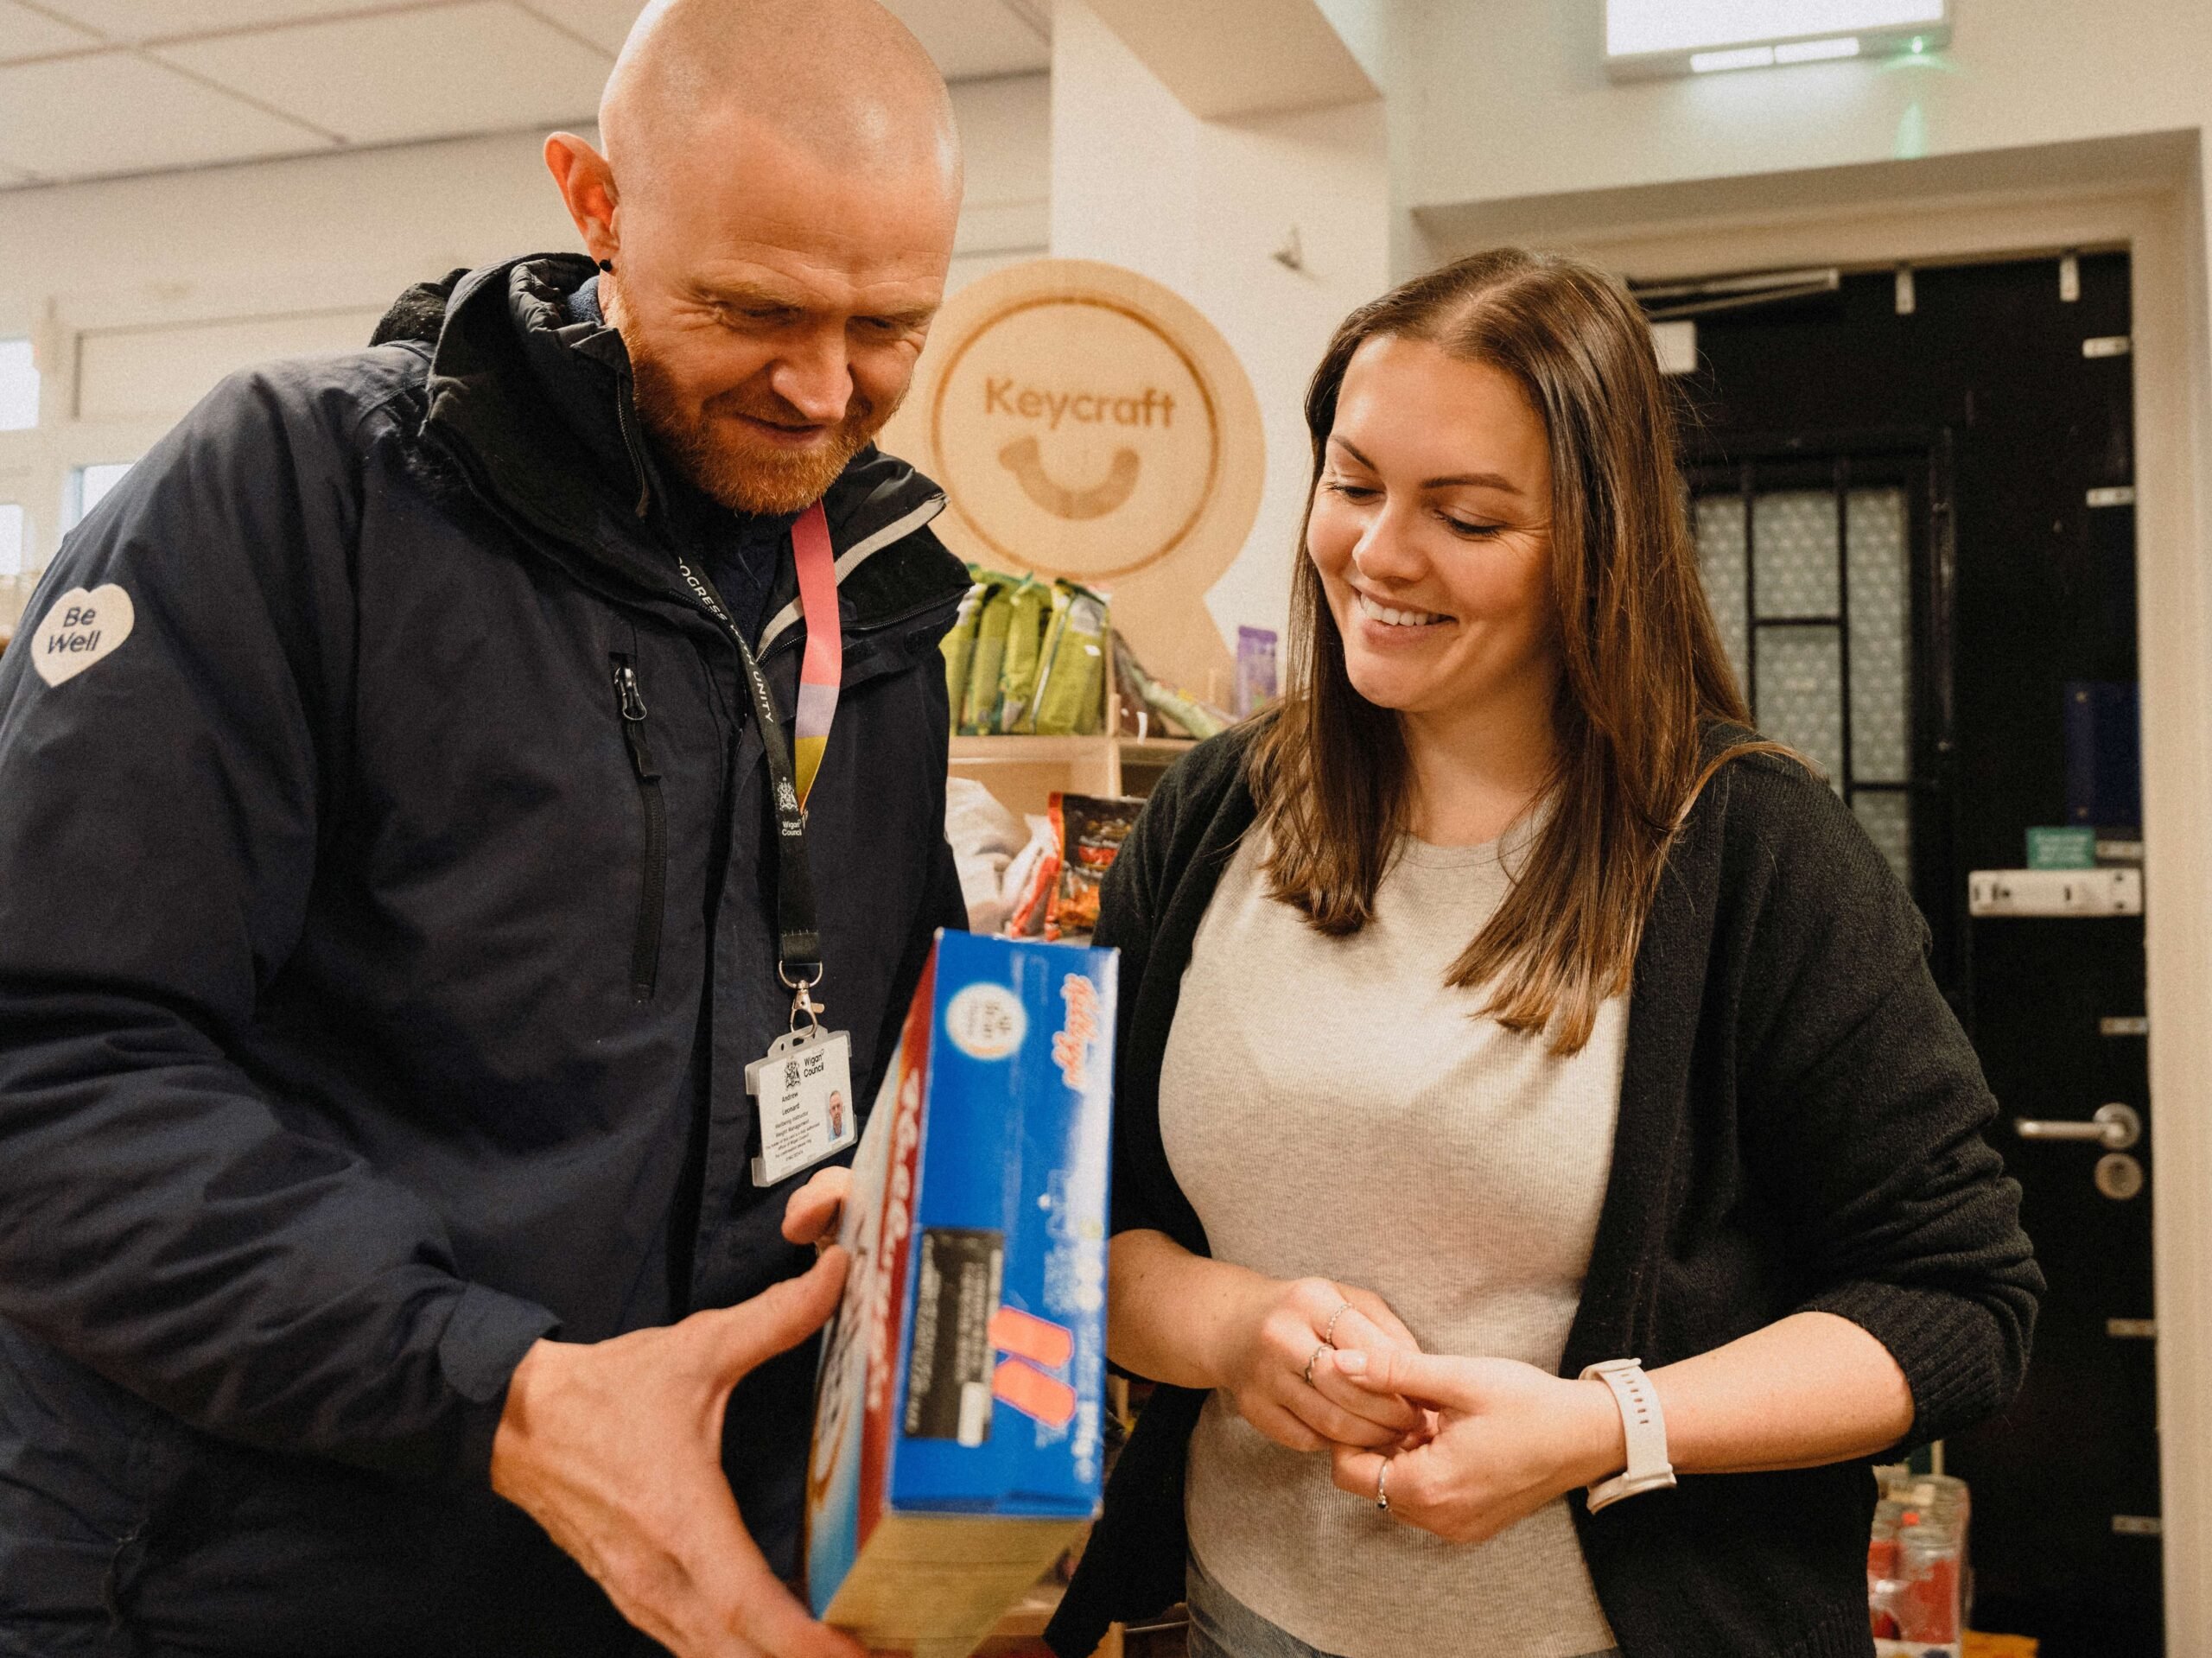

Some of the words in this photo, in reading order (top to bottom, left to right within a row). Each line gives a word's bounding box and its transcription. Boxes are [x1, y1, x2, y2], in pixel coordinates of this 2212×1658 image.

[983, 377, 1176, 430] Keycraft
[63, 607, 97, 628] Be
[48, 630, 102, 655] Well
[678, 556, 728, 621] OGRESS
[753, 670, 775, 723] UNITY
[804, 1054, 823, 1066] Wigan
[804, 1061, 824, 1077] Council
[782, 1092, 798, 1102] Andrew
[782, 1102, 800, 1116] Leonard
